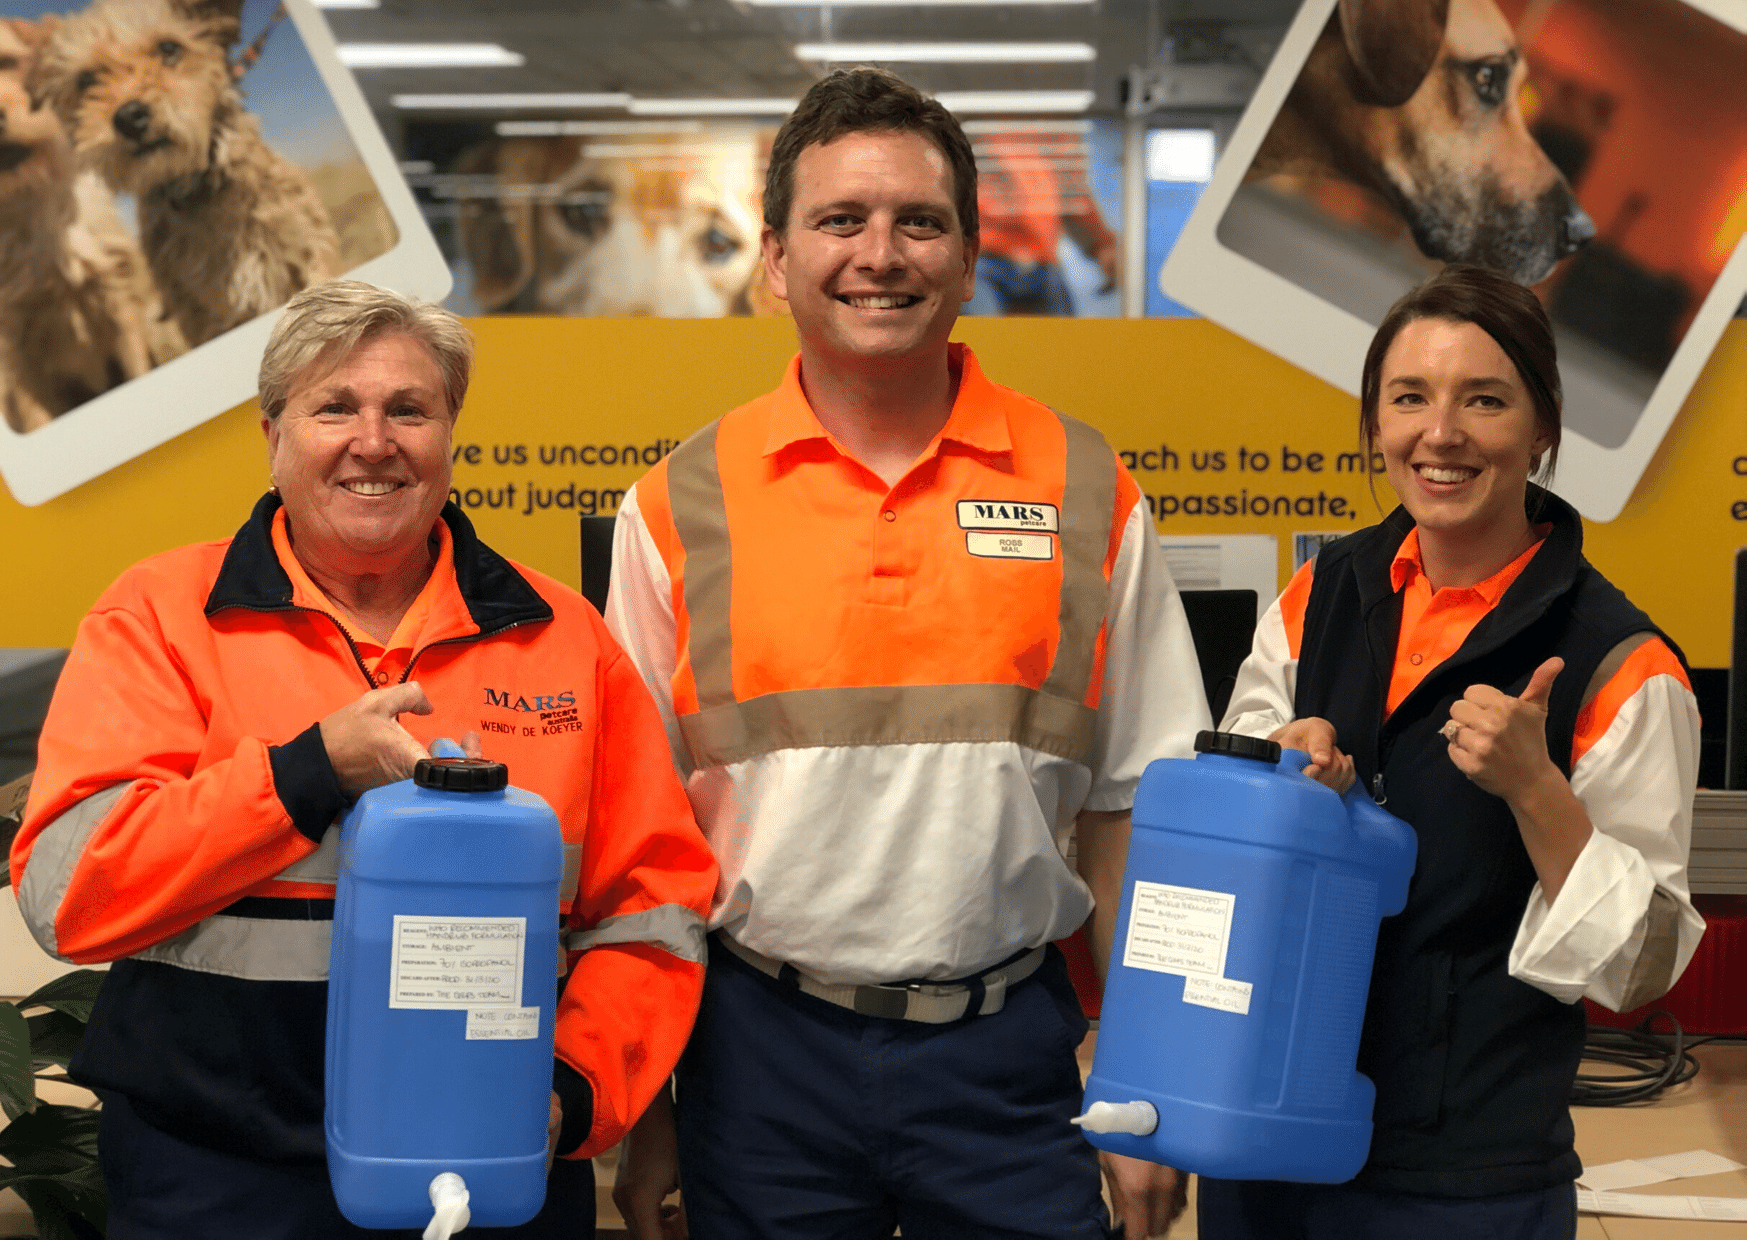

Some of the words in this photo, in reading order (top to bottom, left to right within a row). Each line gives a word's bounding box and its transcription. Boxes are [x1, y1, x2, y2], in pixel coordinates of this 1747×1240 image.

[493, 445, 528, 465] us
[1191, 450, 1227, 471] us
[1238, 446, 1270, 471] to
[1282, 445, 1324, 472] be
[974, 504, 1044, 521] MARS
[483, 688, 576, 713] MARS
[540, 708, 578, 721] petcare
[547, 715, 578, 726] australia
[481, 720, 516, 735] WENDY
[522, 727, 536, 737] DE
[542, 721, 583, 736] KOEYER
